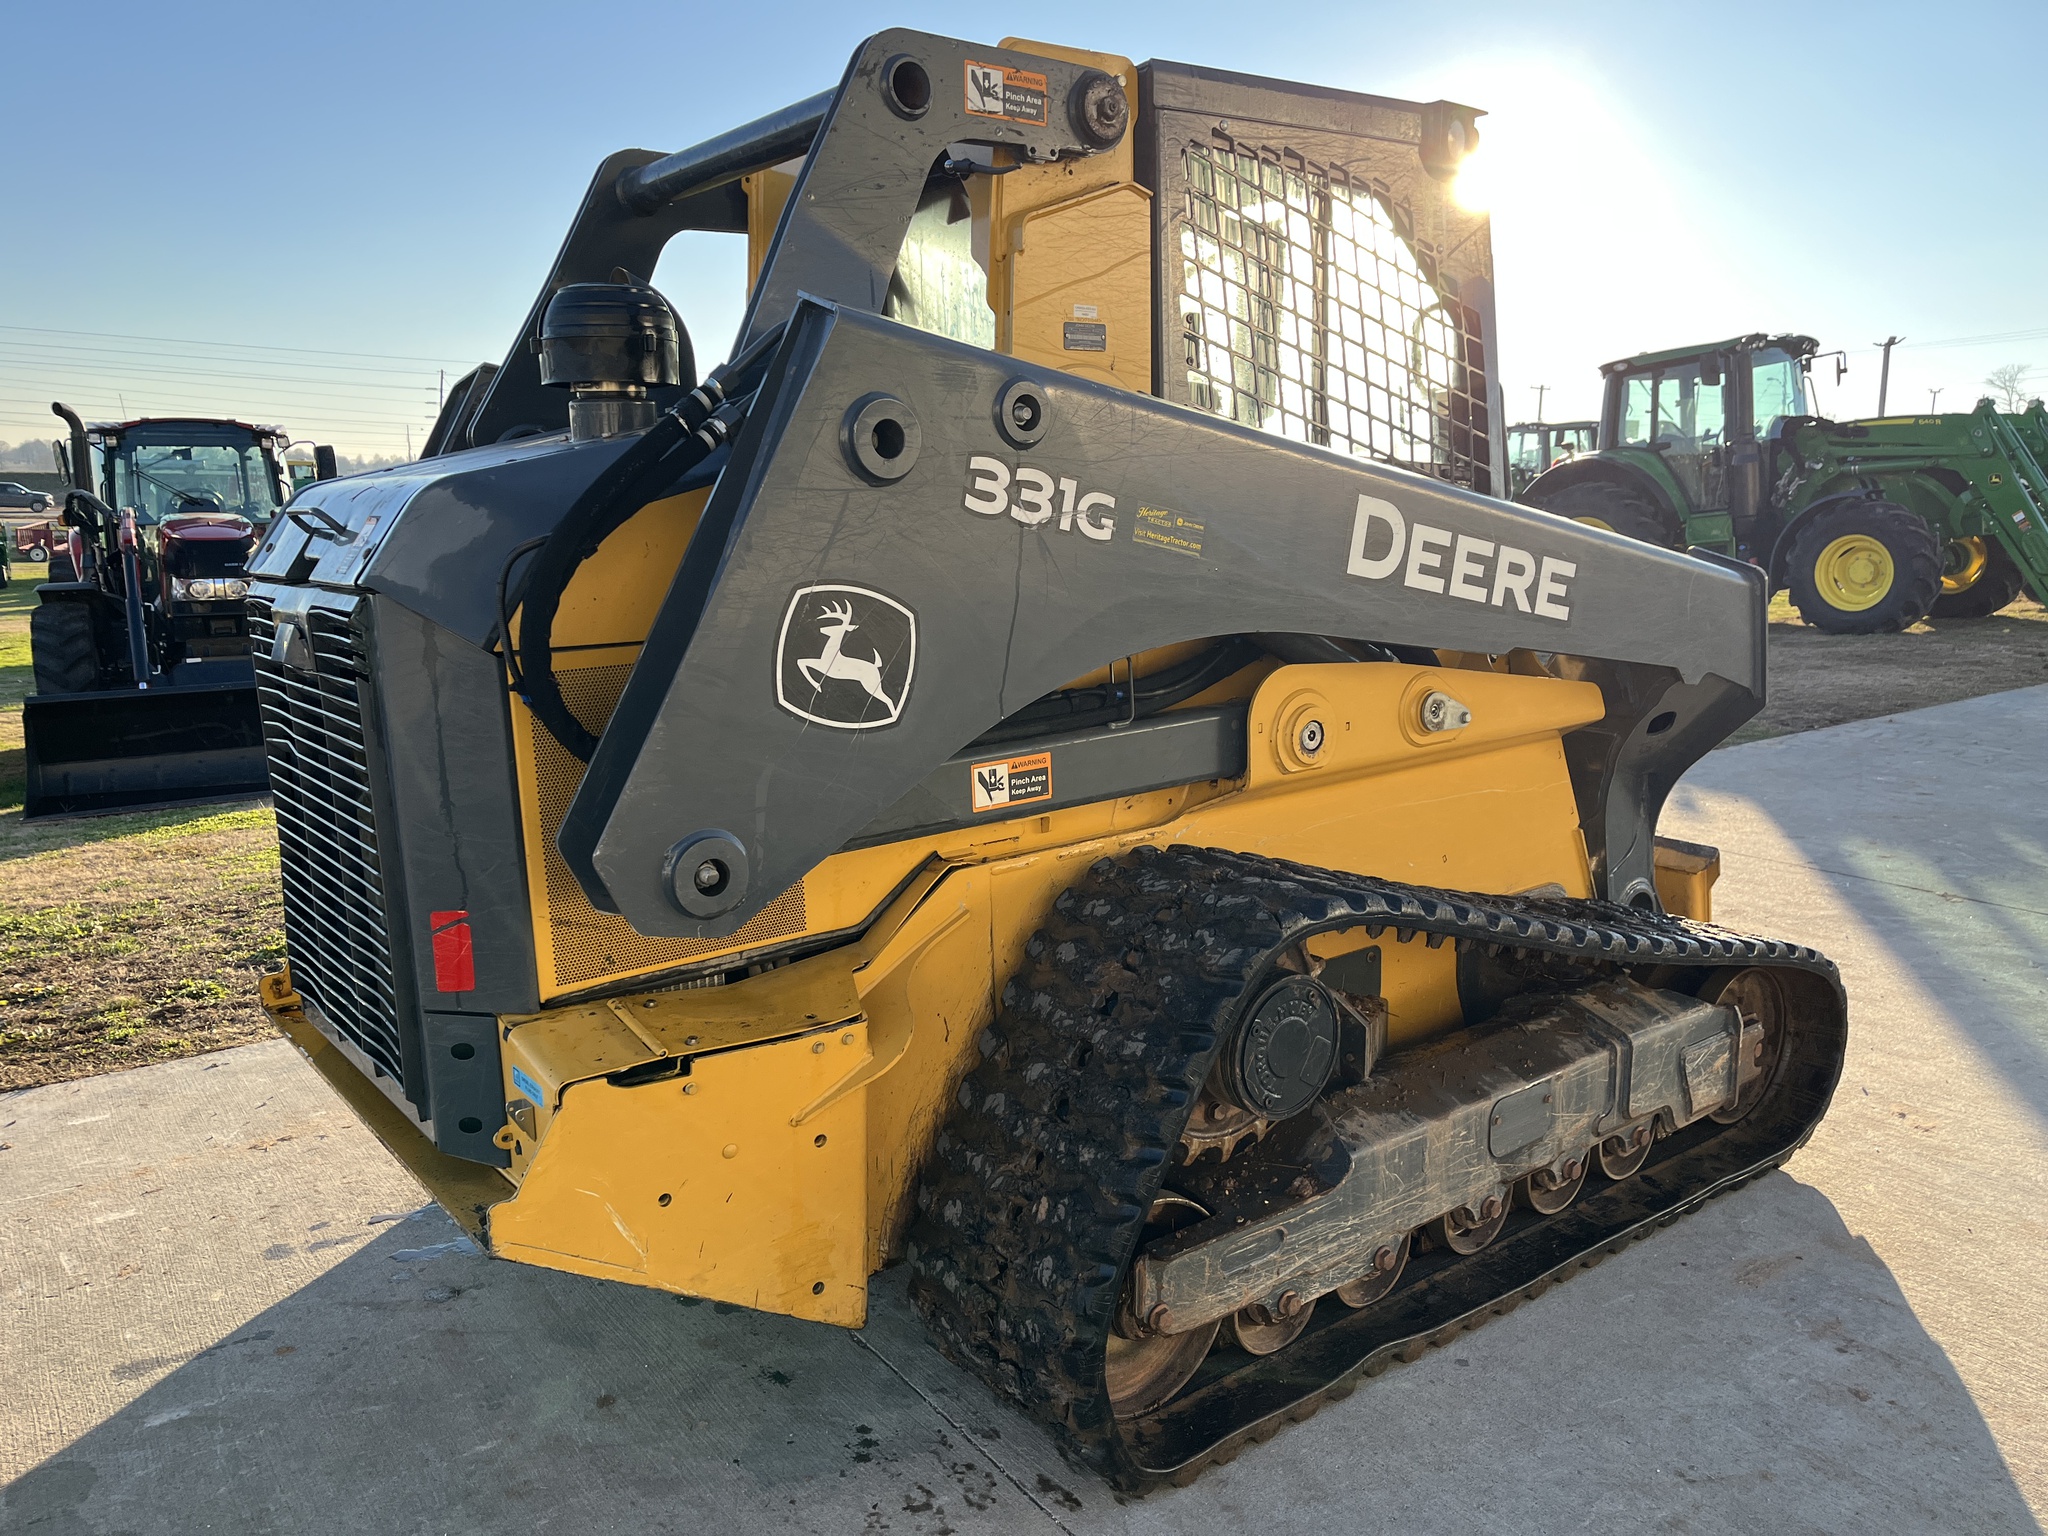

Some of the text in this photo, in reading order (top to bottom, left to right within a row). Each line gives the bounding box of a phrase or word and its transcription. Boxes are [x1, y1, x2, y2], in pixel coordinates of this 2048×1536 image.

[1012, 73, 1043, 86] WARNING
[1005, 91, 1042, 105] Pinch Area
[1005, 102, 1037, 116] Keep Away
[964, 456, 1116, 541] 331G
[1136, 506, 1168, 518] Heritage
[1134, 527, 1202, 550] Visit HeritageTractor.com
[1346, 494, 1577, 621] DEERE
[1017, 757, 1046, 768] WARNING
[1011, 774, 1046, 786] Pinch Area
[1011, 787, 1026, 795] Keep
[1026, 785, 1041, 793] Away
